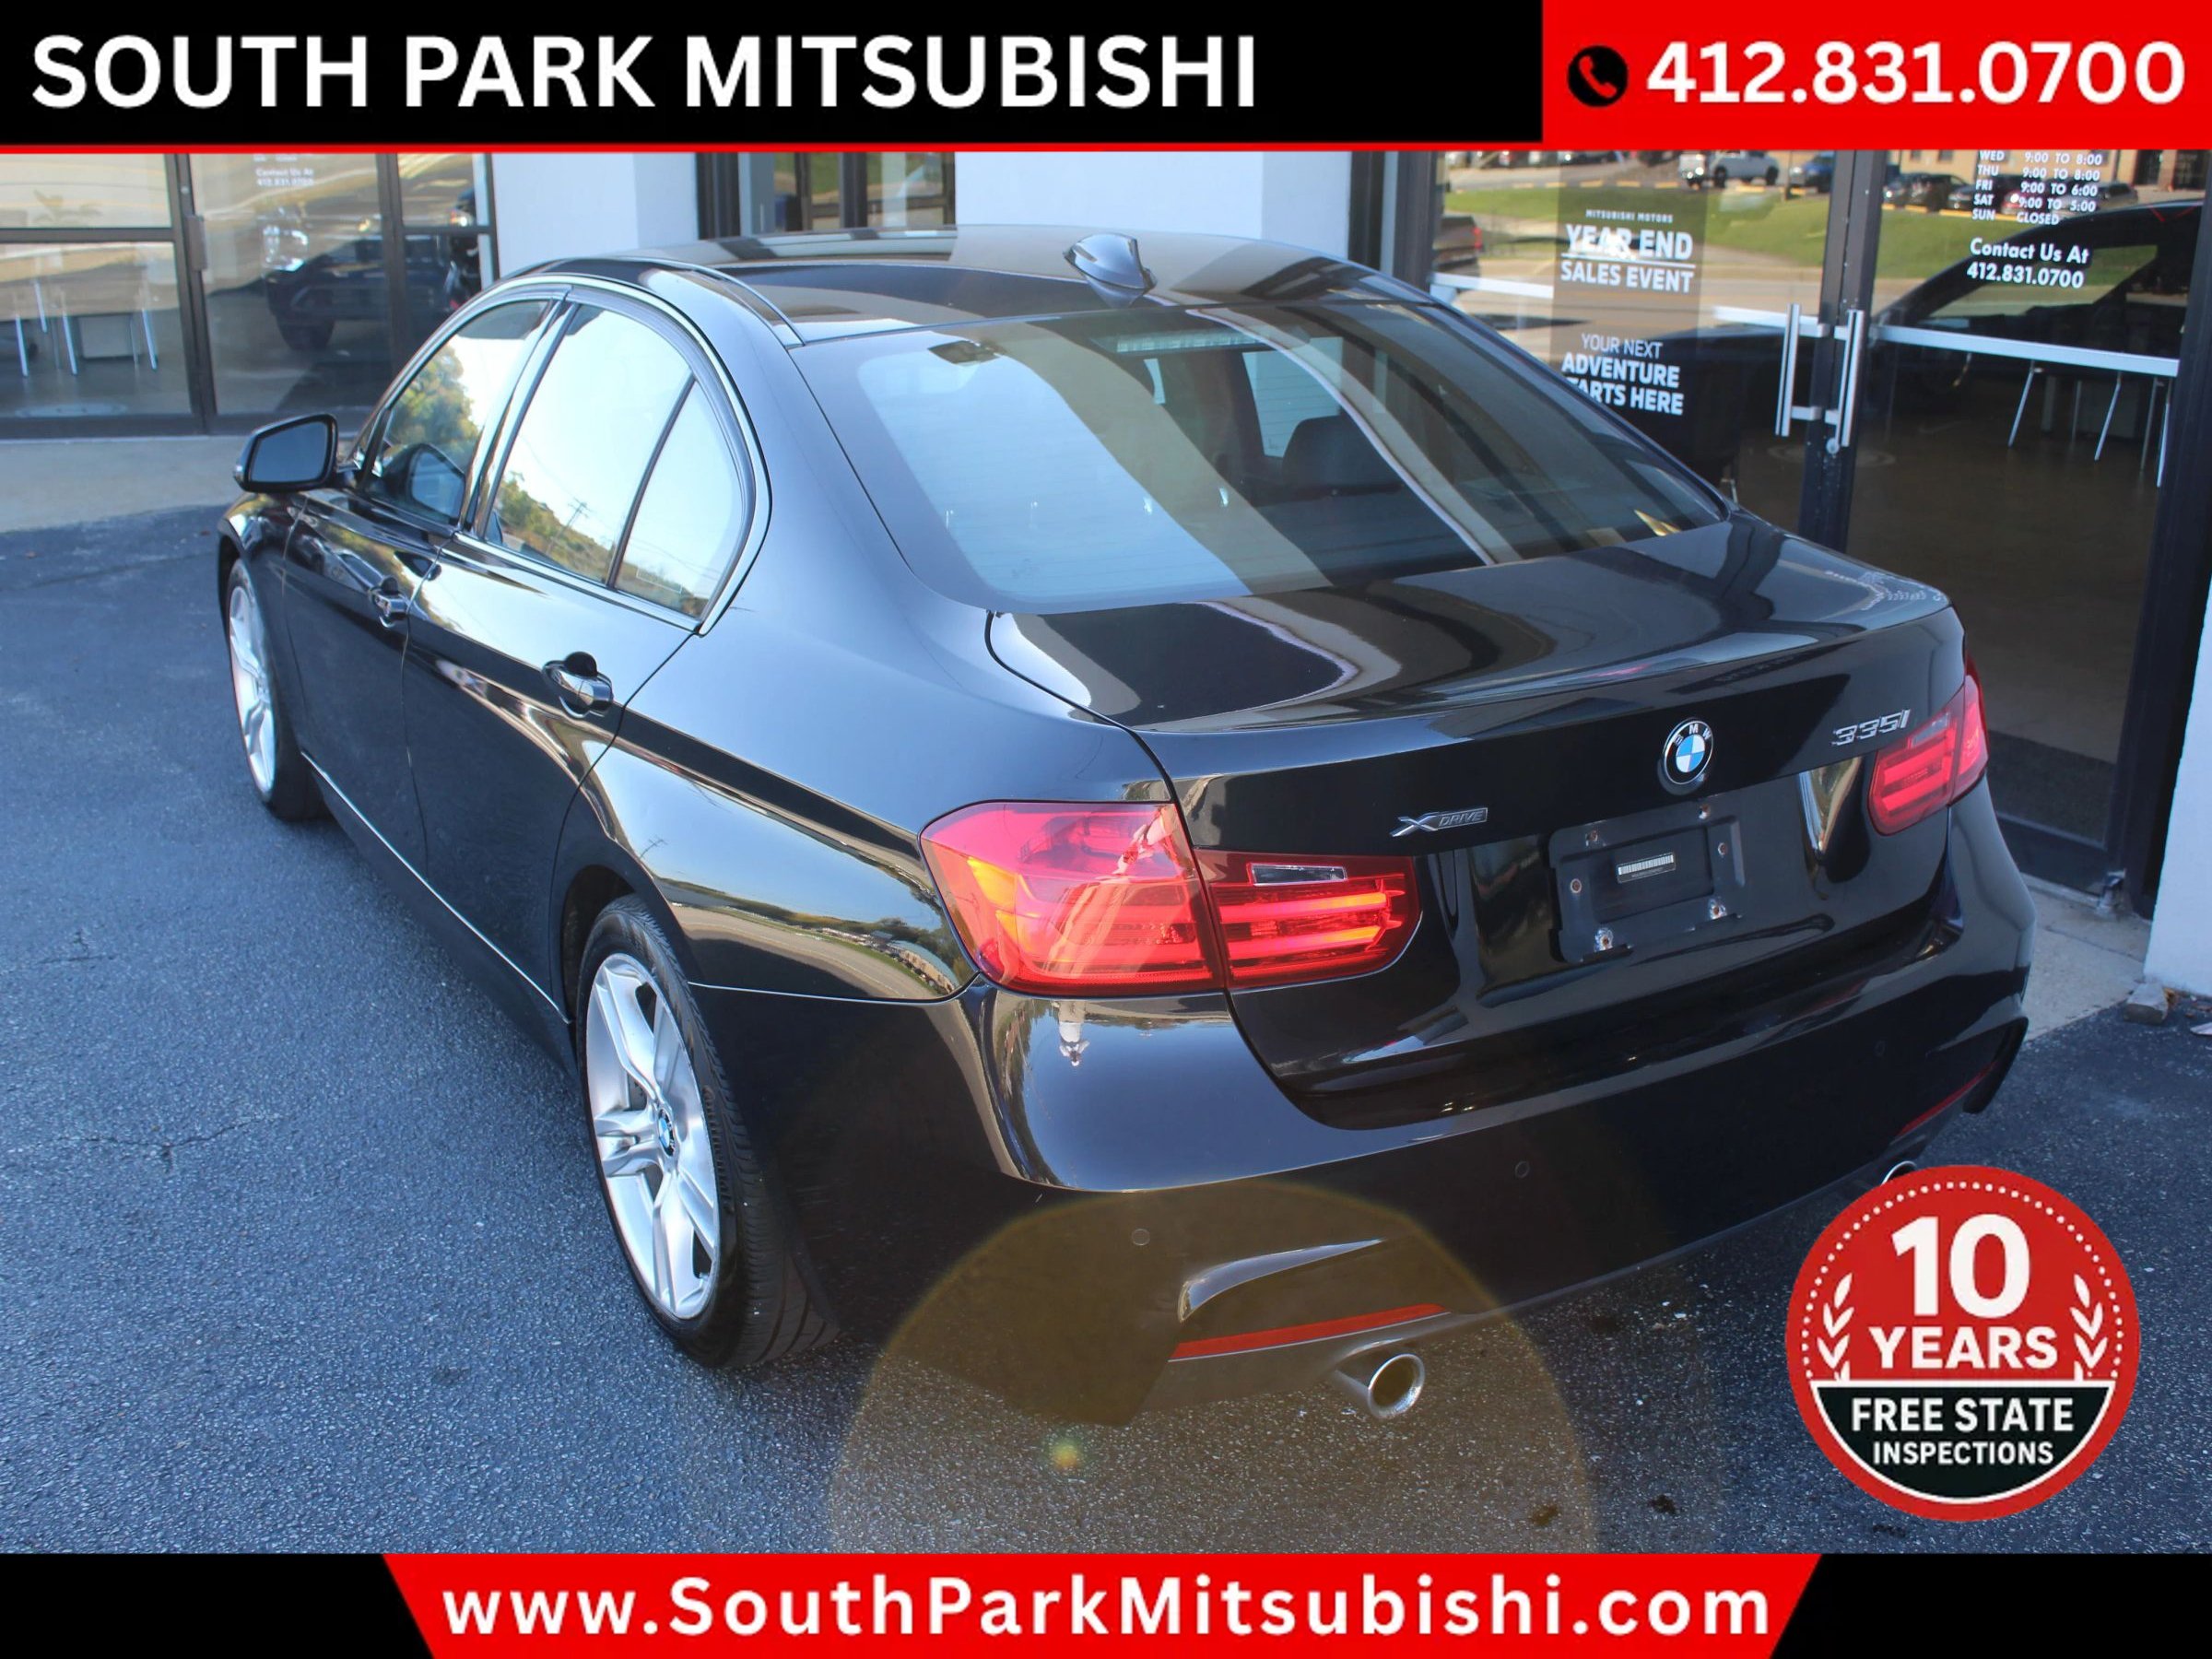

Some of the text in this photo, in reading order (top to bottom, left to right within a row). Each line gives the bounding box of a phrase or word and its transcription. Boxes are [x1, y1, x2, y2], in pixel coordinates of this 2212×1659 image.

[1979, 150, 2102, 166] WED 9:00 TO 8:00
[1977, 165, 2100, 182] THU 9:00 TO 8:00
[1975, 180, 2098, 196] FRI 9:00 TO 6:00
[1973, 194, 2096, 212] SAT 9:00 TO 5:00
[1971, 209, 2060, 225] SUN CLOSED
[1566, 223, 1693, 260] YEAR END
[1970, 237, 2089, 264] Contact Us At
[1560, 259, 1695, 293] SALES EVENT
[1966, 261, 2085, 288] 412.831.0700
[1582, 333, 1664, 359] YOUR NEXT
[1561, 351, 1680, 388] ADVENTURE
[1630, 385, 1684, 415] HERE
[1674, 724, 1712, 747] BMW
